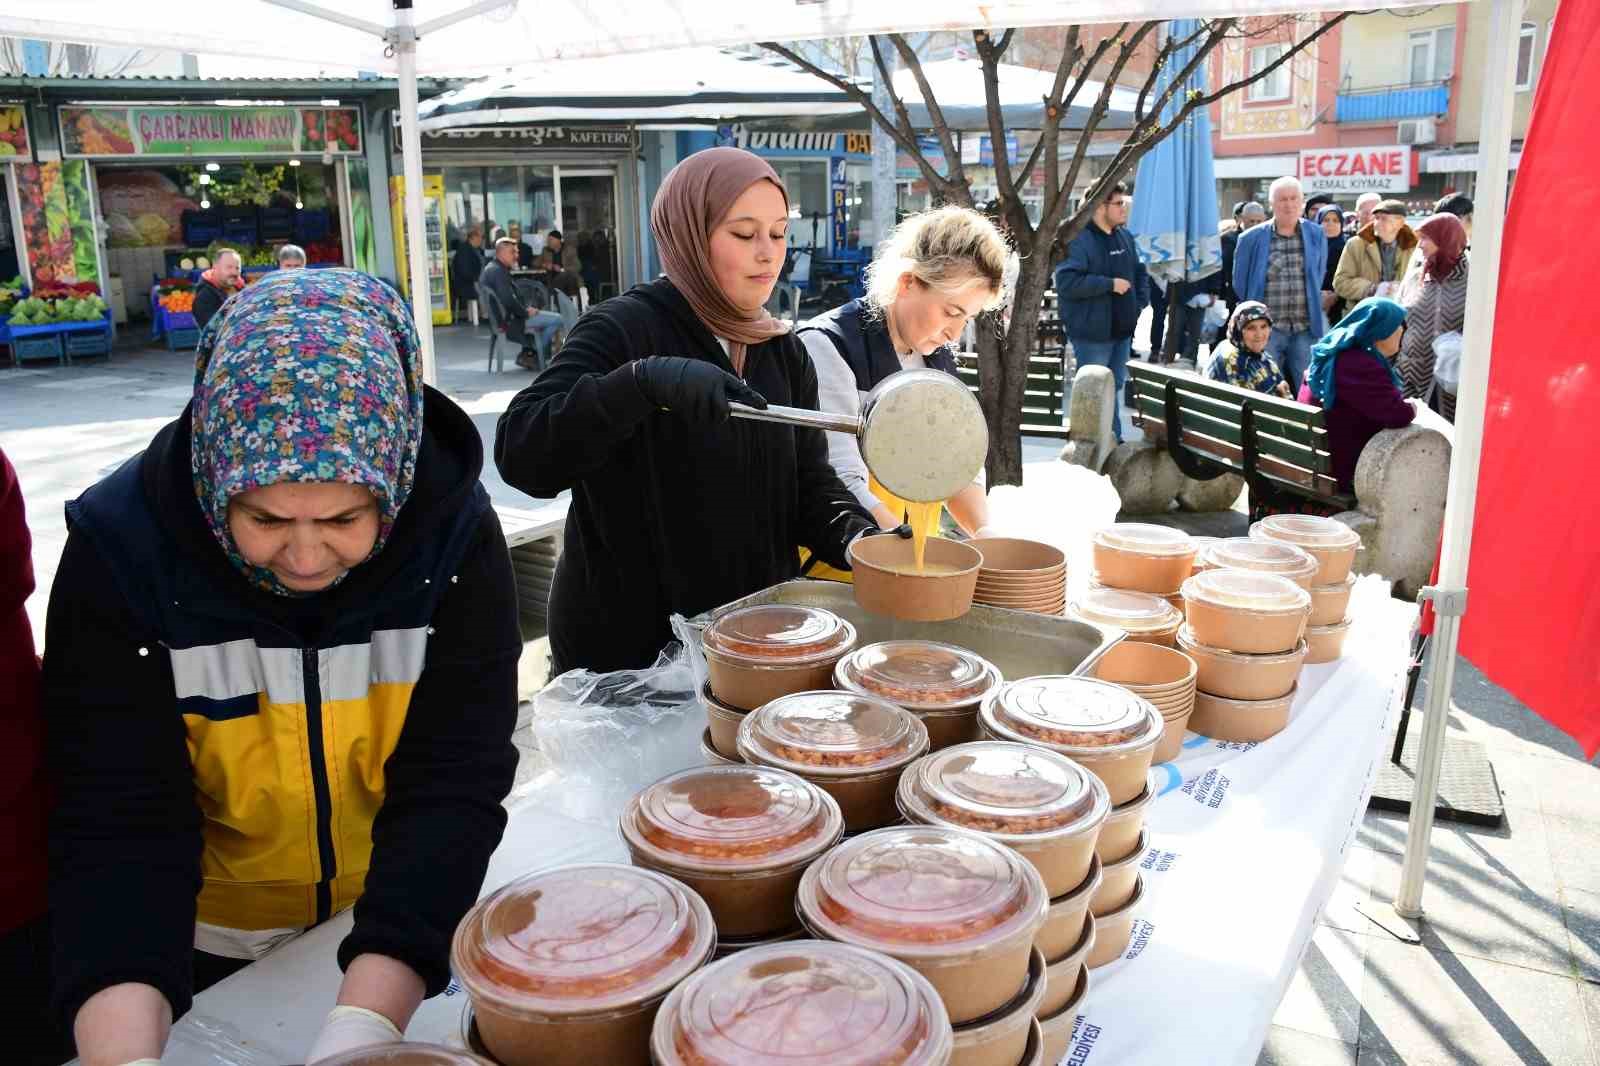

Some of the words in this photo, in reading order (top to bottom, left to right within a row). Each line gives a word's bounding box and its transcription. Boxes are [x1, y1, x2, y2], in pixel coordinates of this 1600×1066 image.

[1303, 151, 1402, 177] ECZANE
[1312, 179, 1347, 190] KEMAL
[1350, 178, 1393, 190] KIYMAZ
[1067, 1022, 1103, 1066] ELEDİYESİ
